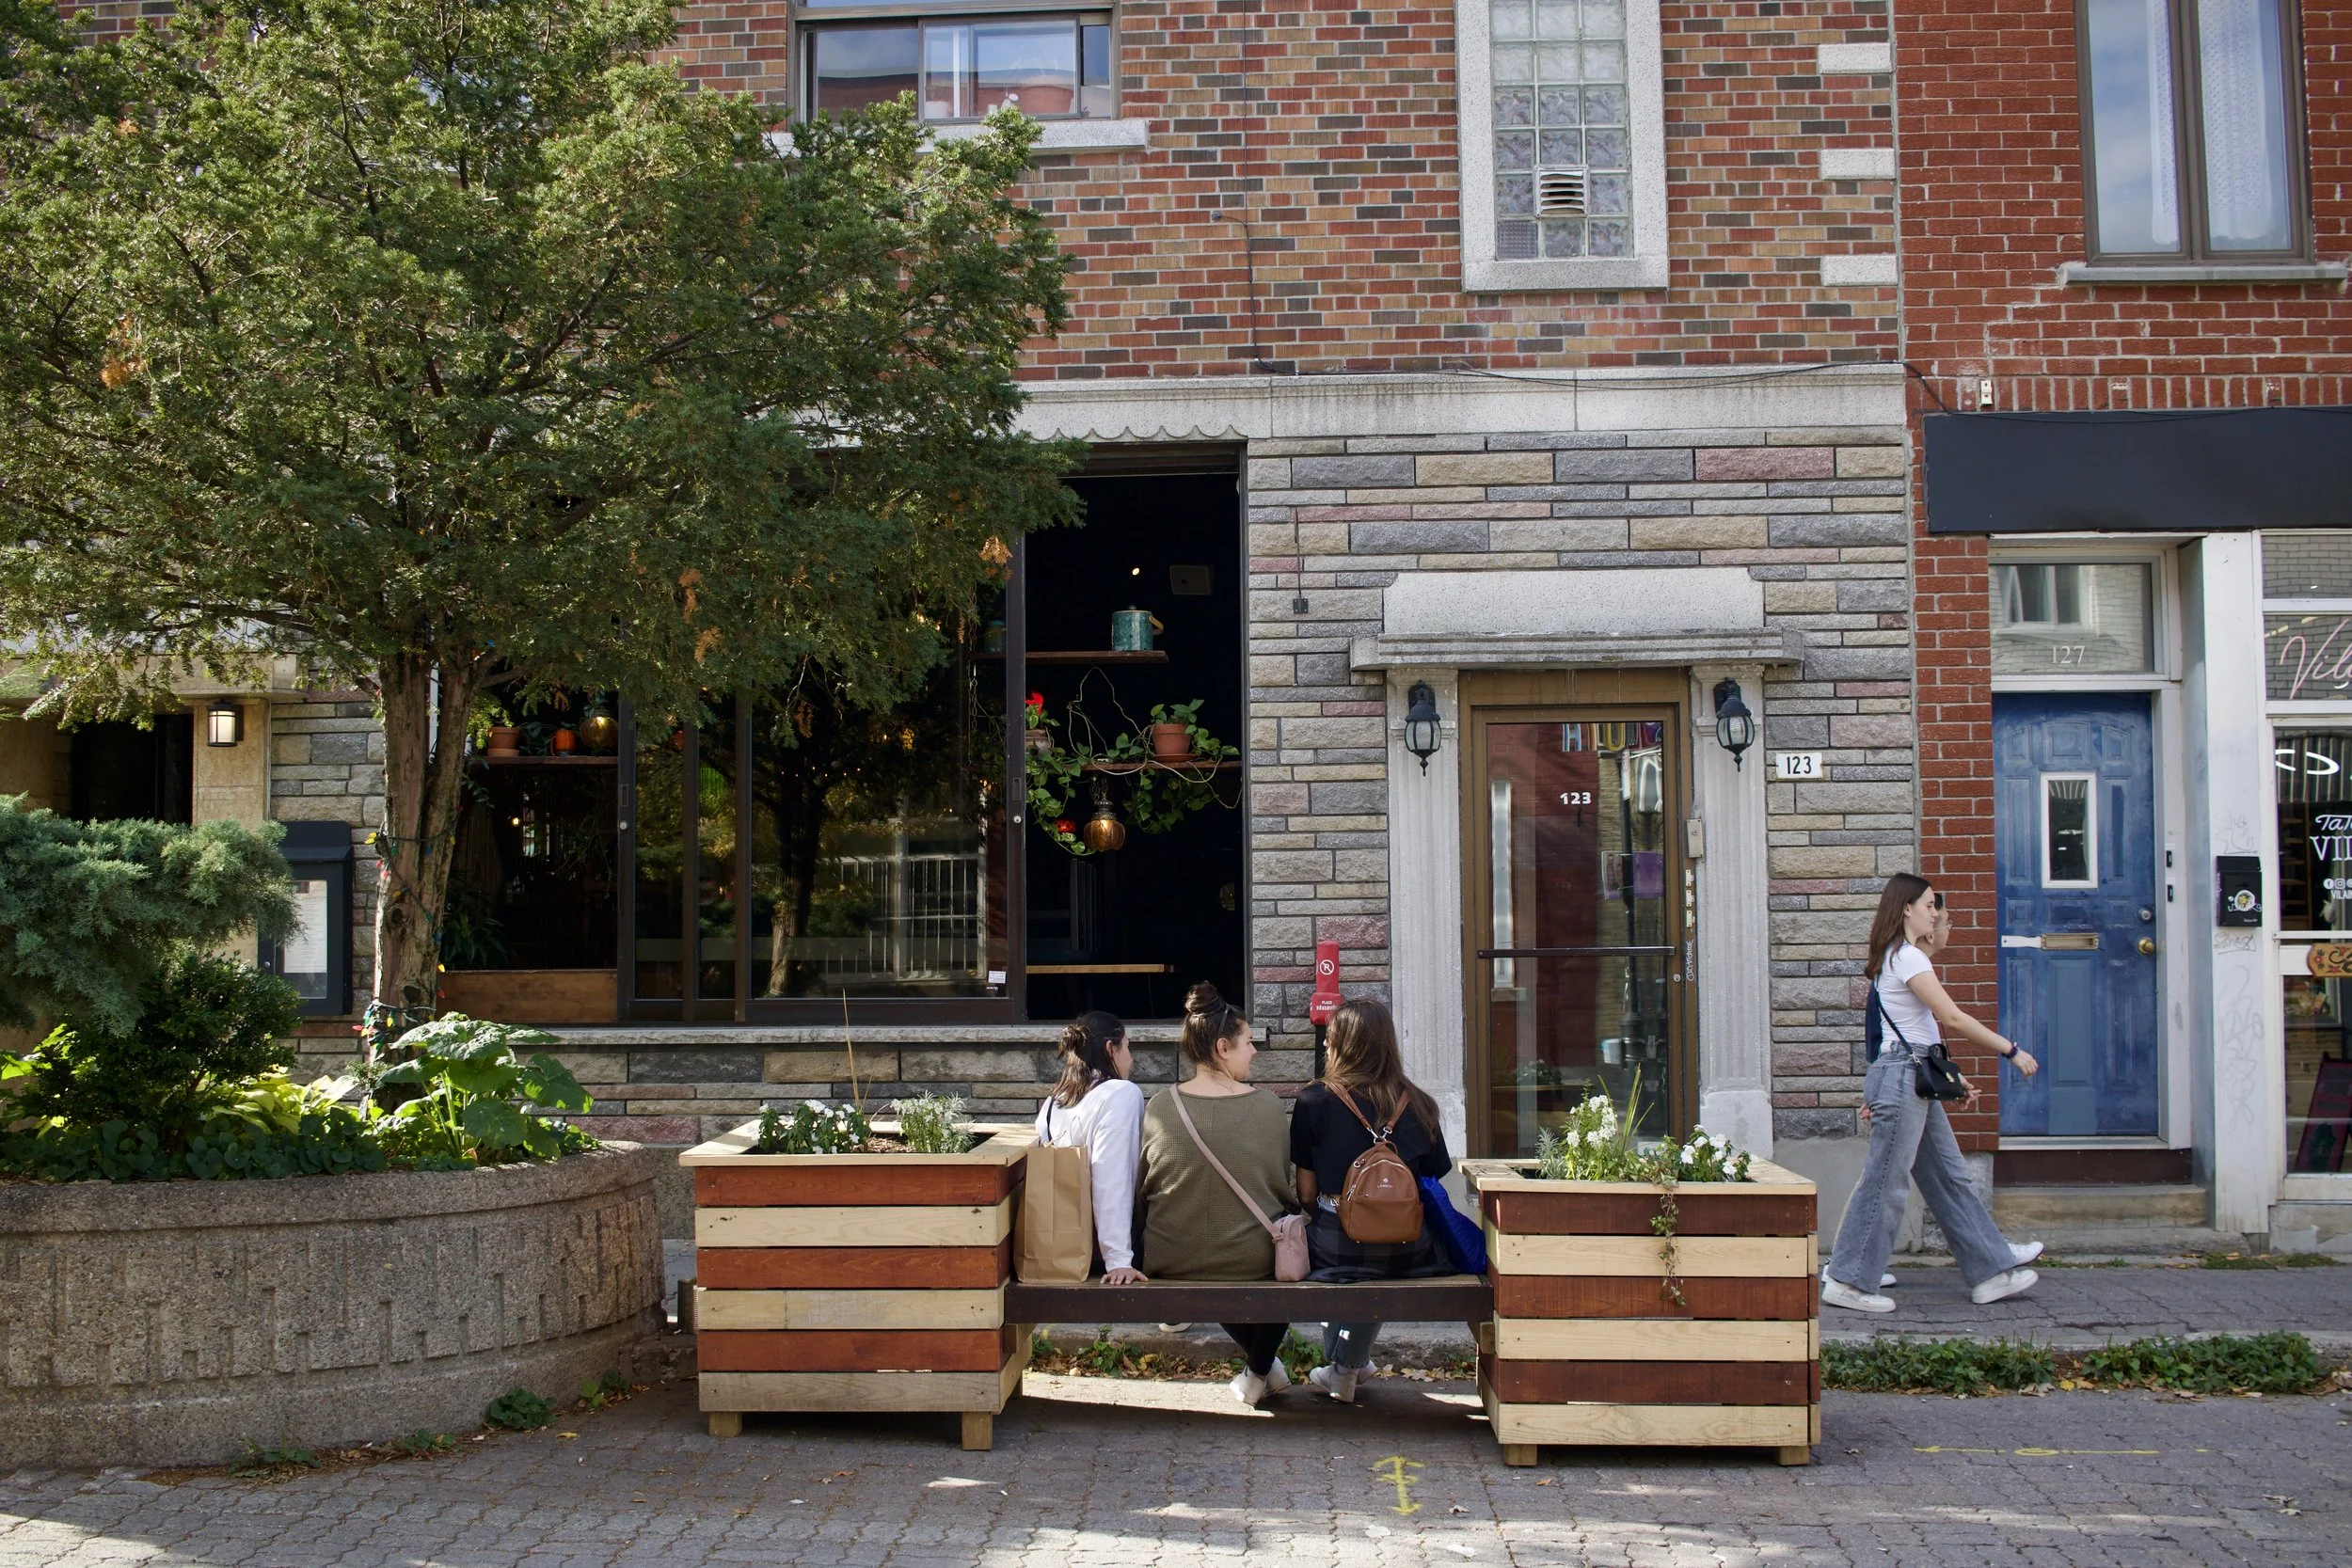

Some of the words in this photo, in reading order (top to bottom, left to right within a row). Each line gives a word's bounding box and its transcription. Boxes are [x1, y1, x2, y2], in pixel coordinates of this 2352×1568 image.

[2052, 645, 2086, 664] 127
[2279, 617, 2352, 700] Vil
[1787, 755, 1812, 774] 123
[1560, 792, 1592, 804] 123
[2314, 814, 2352, 831] TaT
